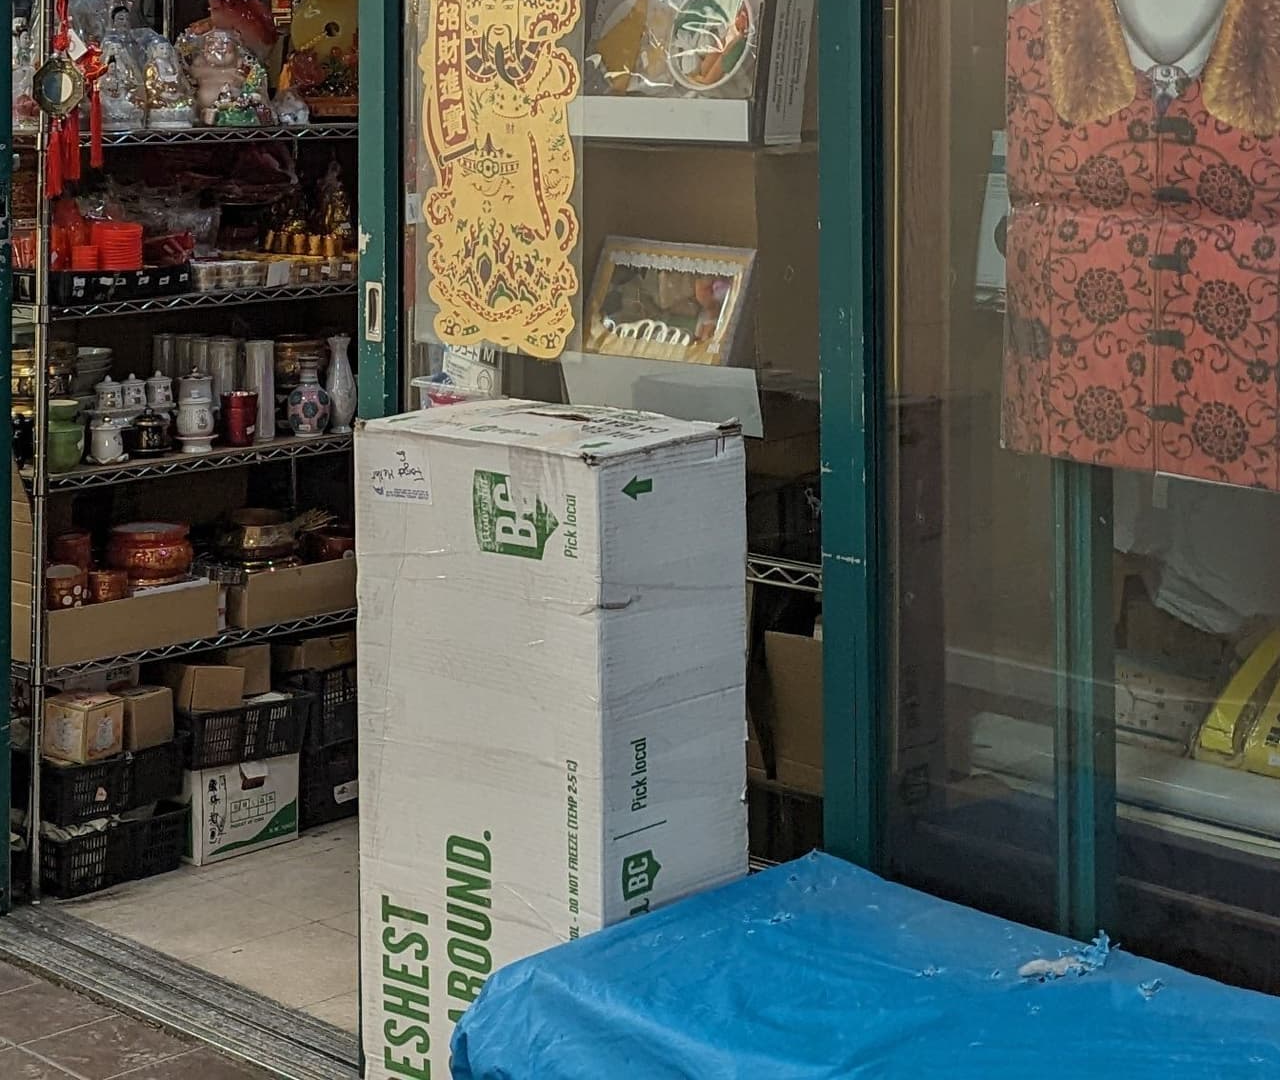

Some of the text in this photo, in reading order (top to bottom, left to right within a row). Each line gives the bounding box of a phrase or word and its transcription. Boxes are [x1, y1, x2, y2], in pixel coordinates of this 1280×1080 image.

[483, 346, 495, 364] M
[563, 530, 579, 559] Pick
[566, 773, 578, 794] 2-5
[631, 736, 649, 811] Pick local
[567, 831, 579, 871] FREEZE
[568, 872, 579, 896] NOT
[627, 858, 650, 893] BC
[568, 898, 580, 914] DO
[381, 894, 431, 1080] ESHEST
